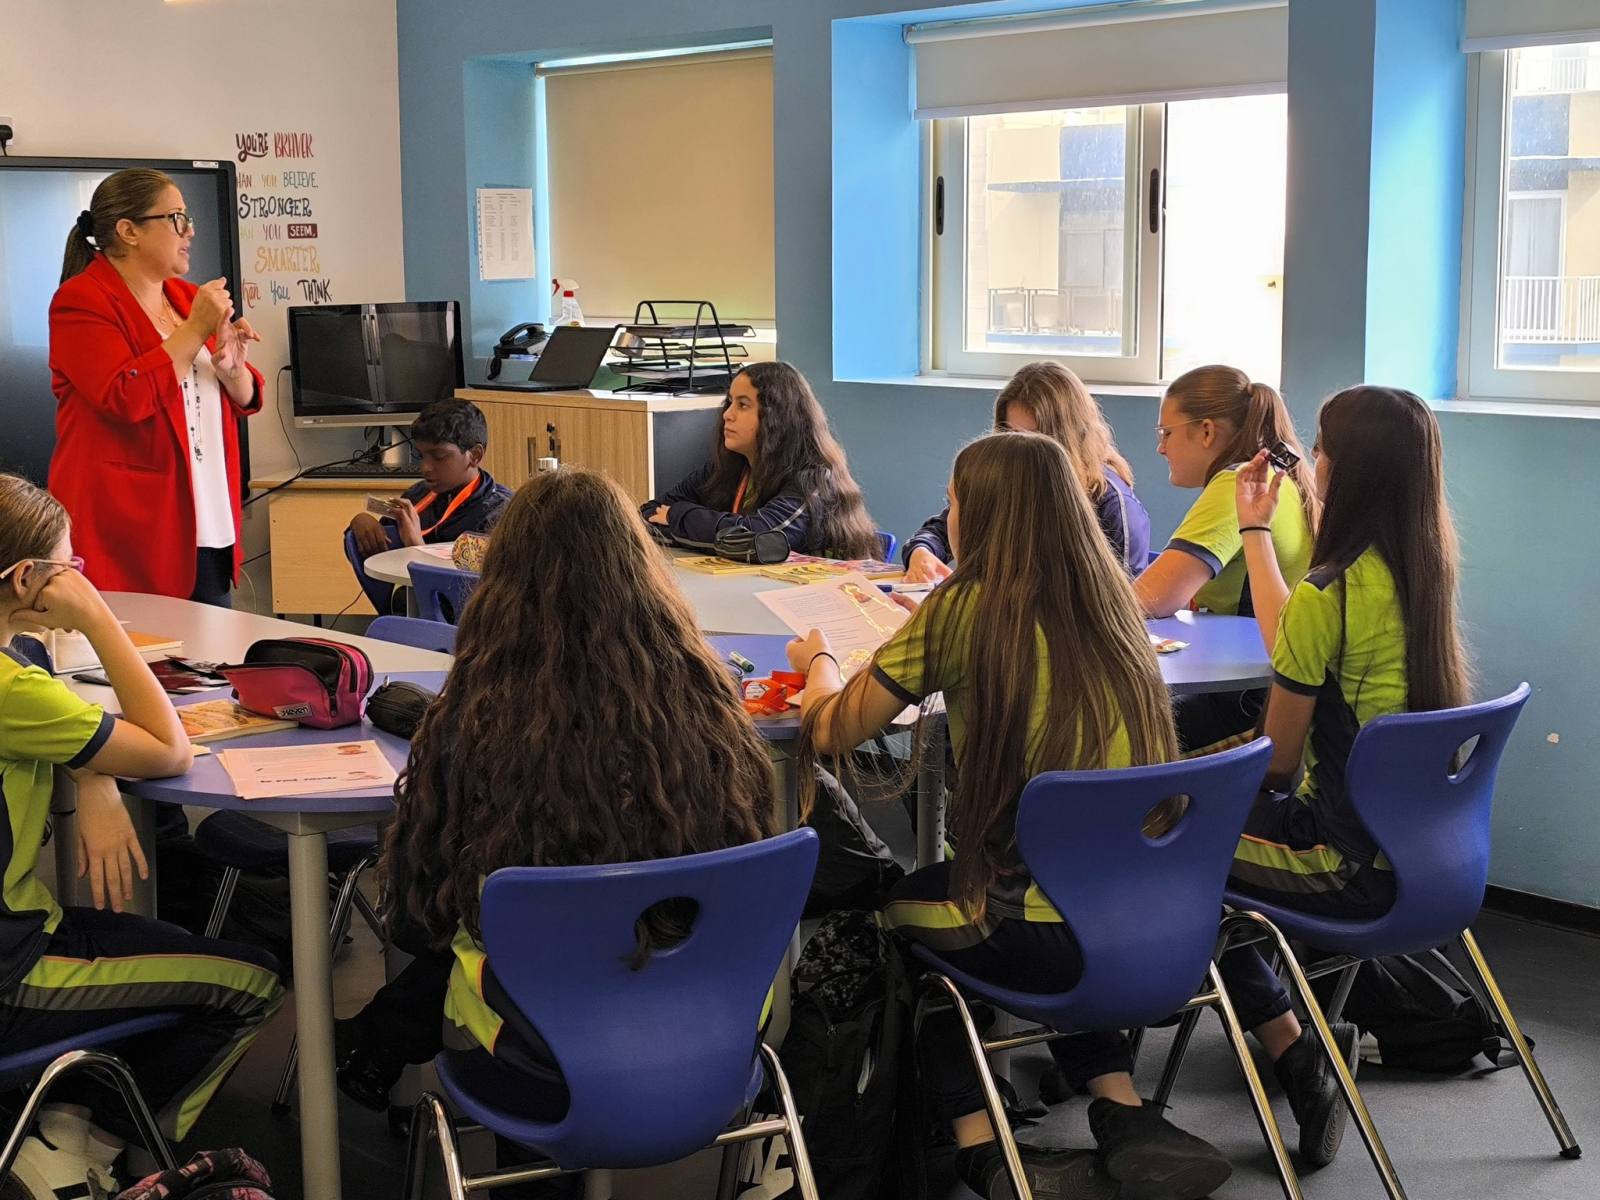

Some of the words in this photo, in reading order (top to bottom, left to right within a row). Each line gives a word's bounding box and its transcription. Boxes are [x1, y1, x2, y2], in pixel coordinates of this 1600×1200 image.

[274, 132, 315, 159] BRAVER
[236, 172, 252, 188] HAN
[261, 174, 277, 188] YOU
[239, 193, 313, 219] STRONGER
[263, 224, 281, 240] YOU
[255, 245, 320, 273] SMARTER
